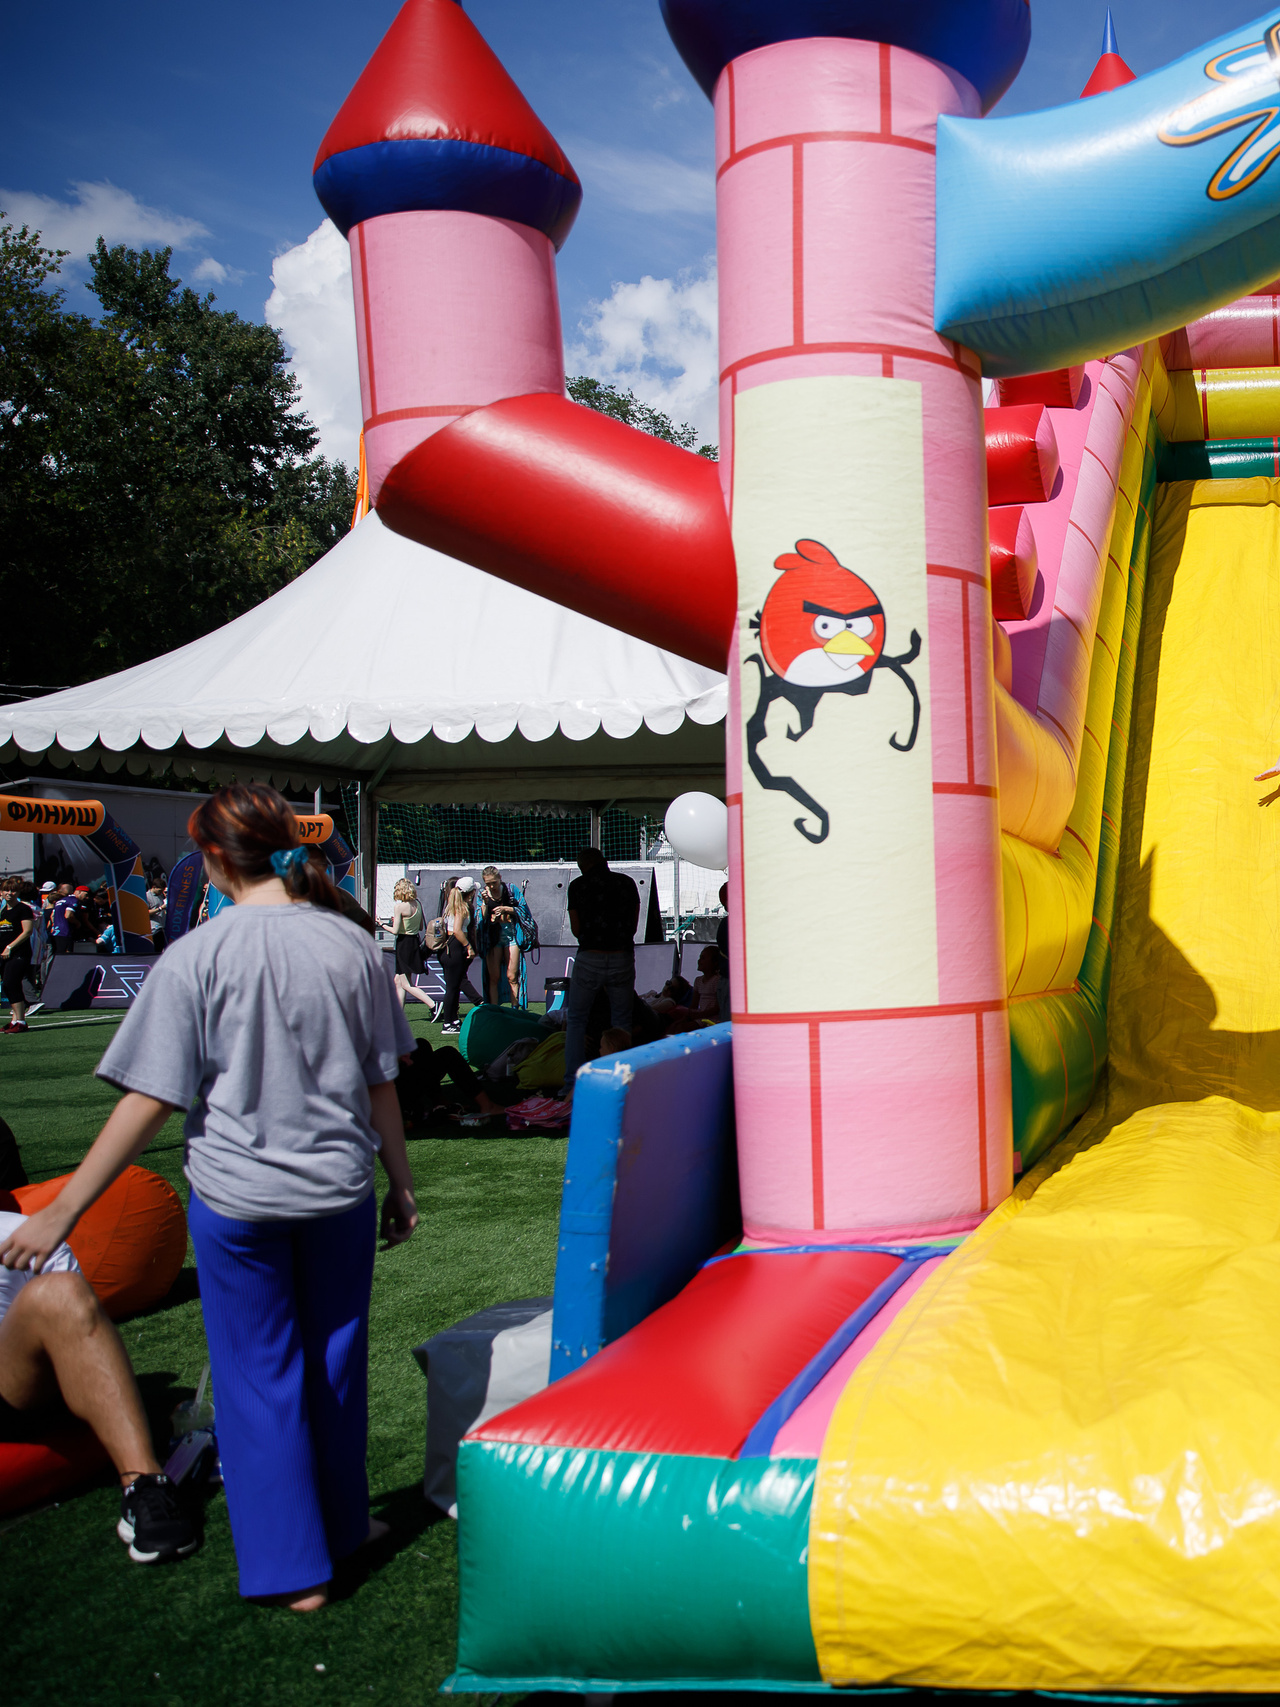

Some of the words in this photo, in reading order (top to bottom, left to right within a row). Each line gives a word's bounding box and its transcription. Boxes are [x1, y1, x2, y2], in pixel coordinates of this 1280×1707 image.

[8, 801, 97, 827] ФИНИШ
[299, 821, 324, 838] АРТ
[176, 865, 194, 908] FITNESS
